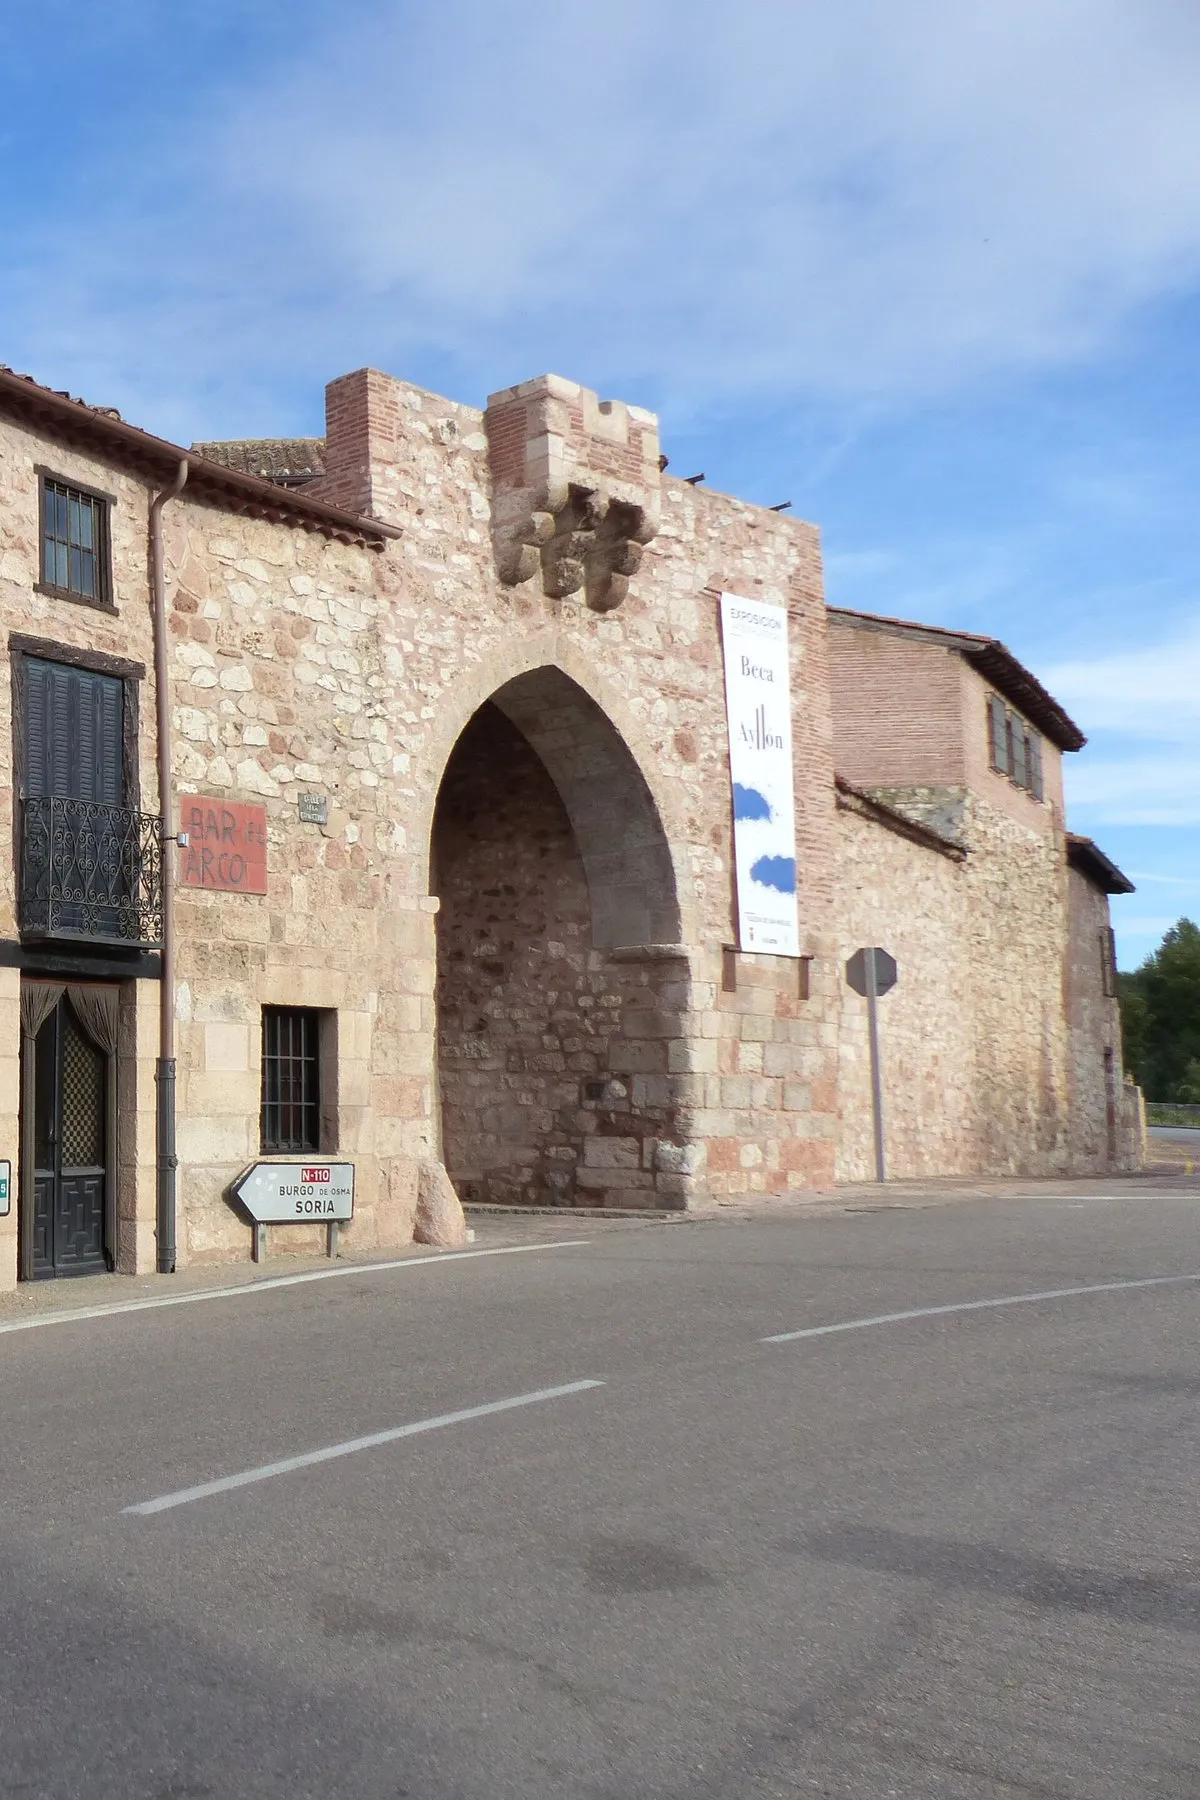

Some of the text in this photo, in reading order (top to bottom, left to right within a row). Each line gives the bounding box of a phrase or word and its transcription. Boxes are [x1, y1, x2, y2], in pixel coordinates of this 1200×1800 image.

[740, 655, 774, 683] Beca
[188, 807, 237, 846] BAR
[185, 846, 246, 885] ARCO
[303, 1170, 329, 1181] N-110
[279, 1185, 351, 1196] BURGO DE OSMA
[295, 1200, 335, 1214] SORIA
